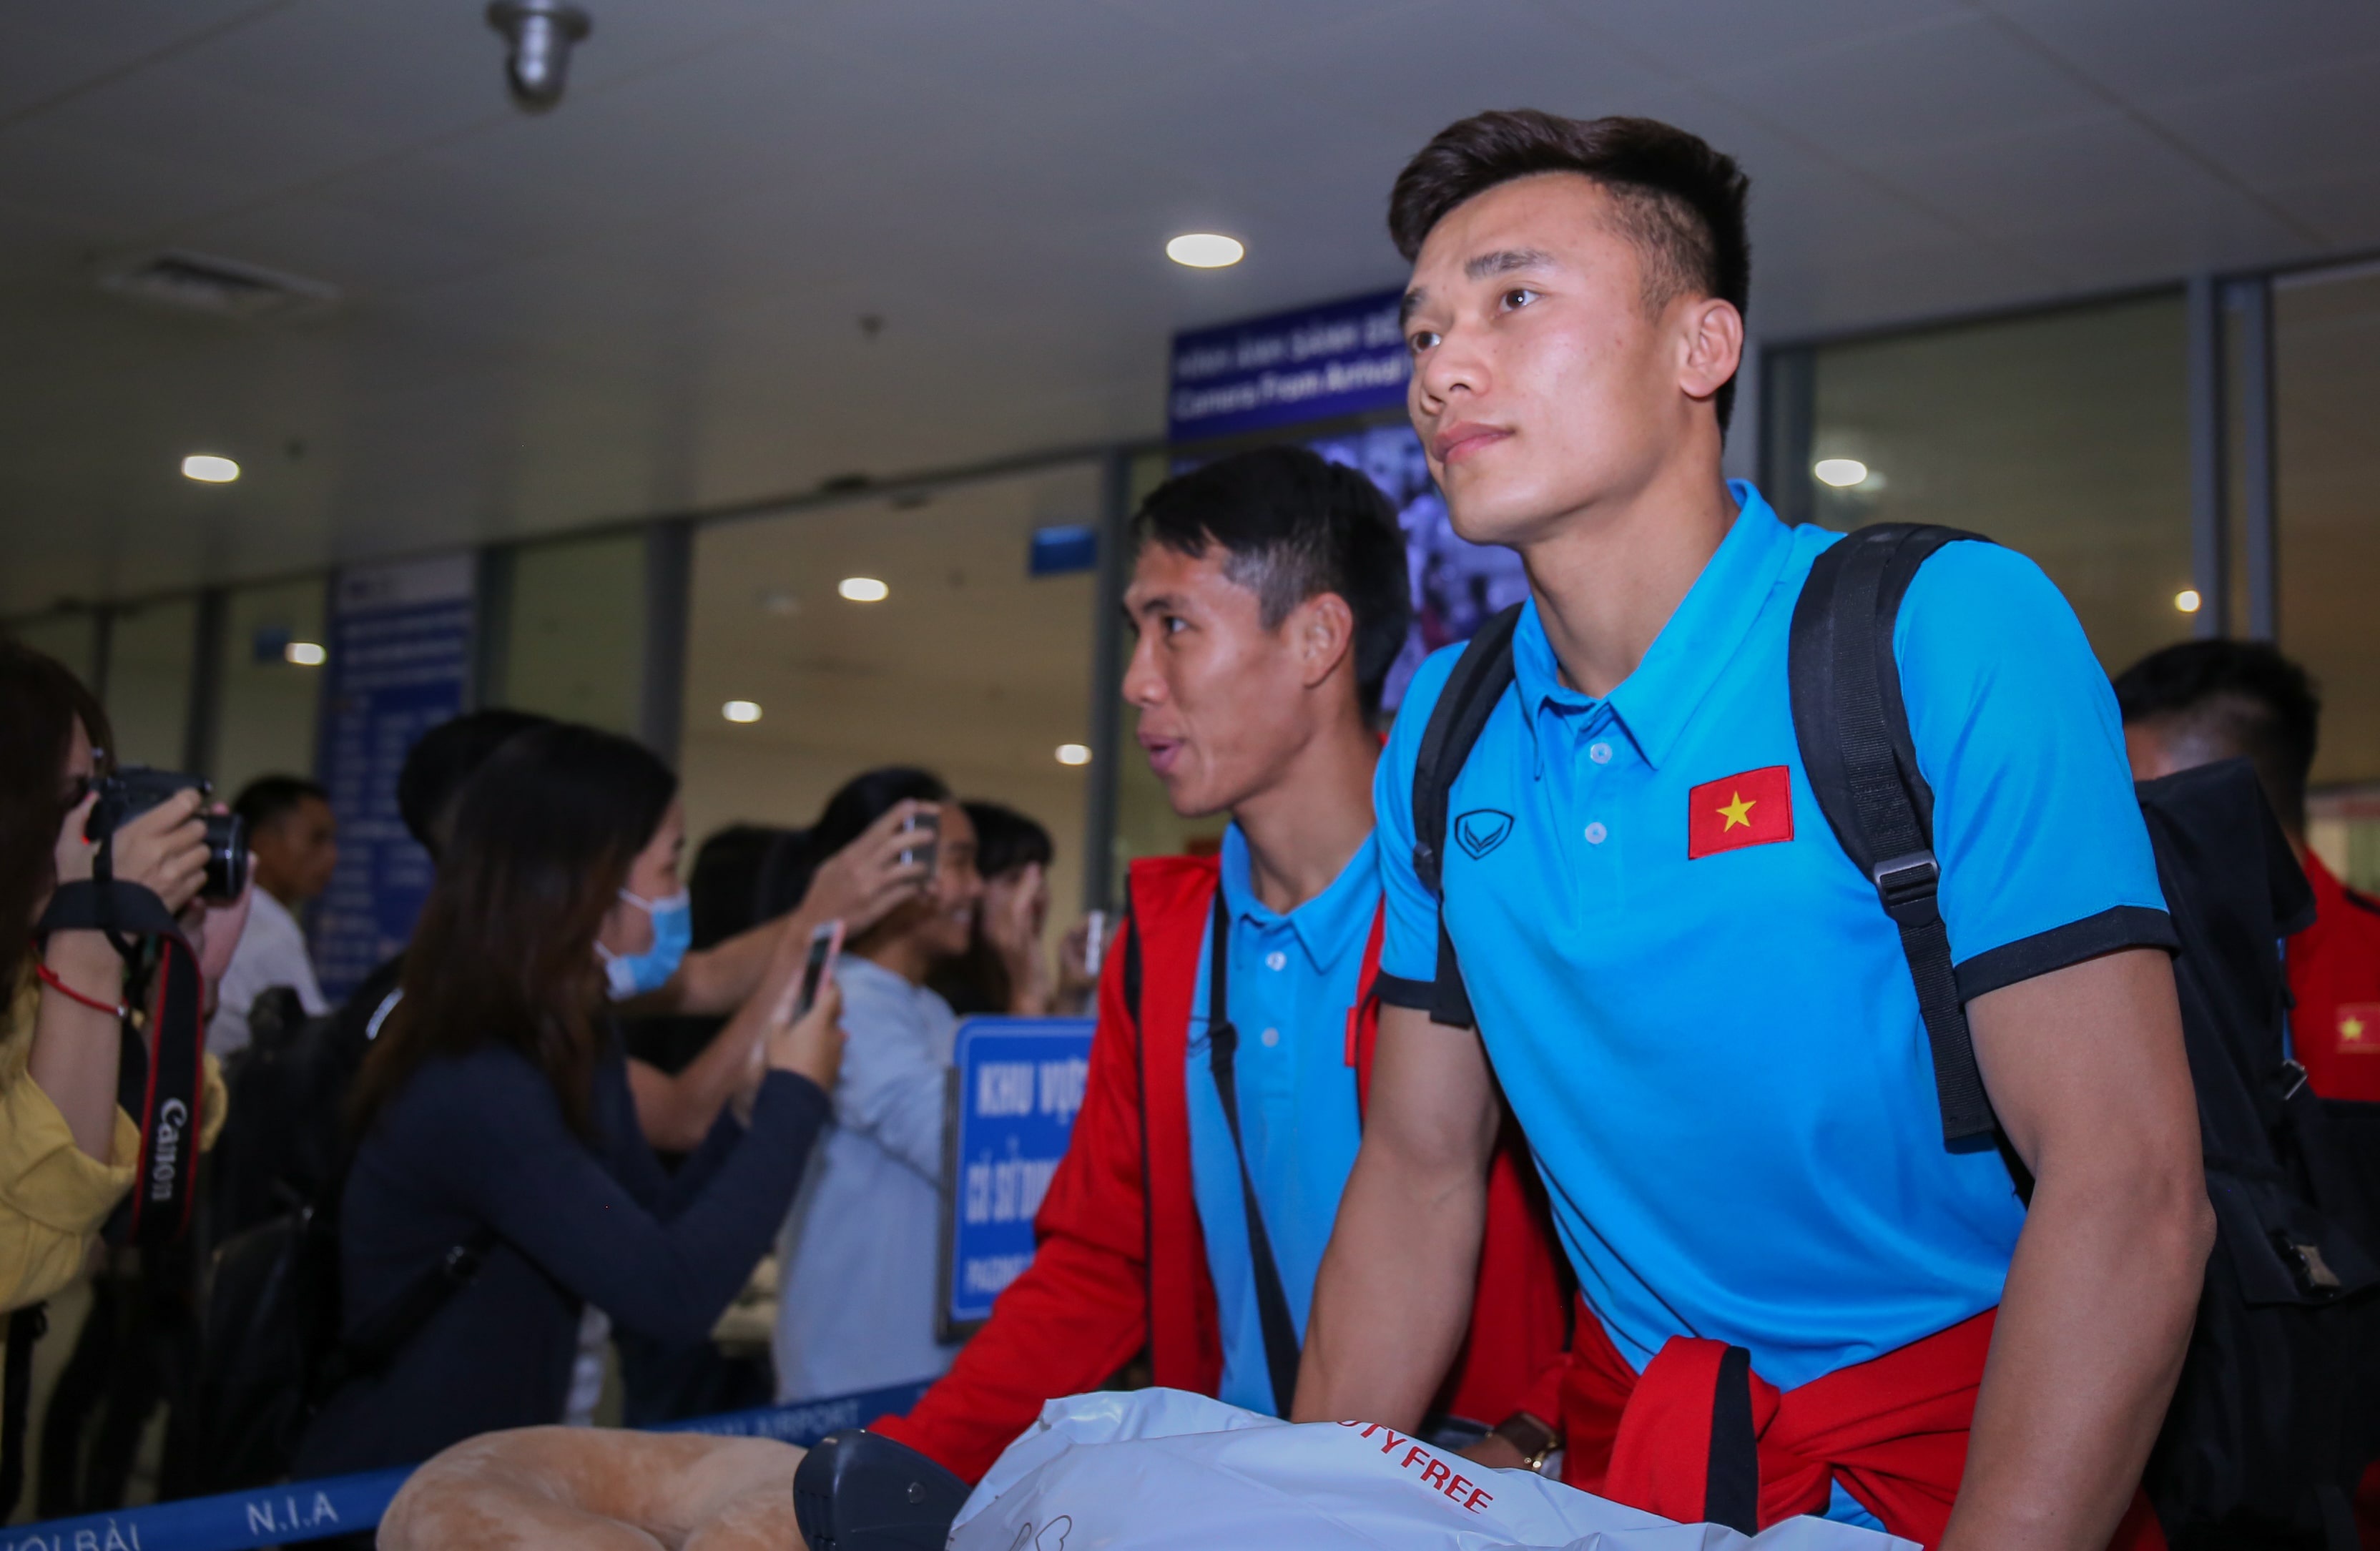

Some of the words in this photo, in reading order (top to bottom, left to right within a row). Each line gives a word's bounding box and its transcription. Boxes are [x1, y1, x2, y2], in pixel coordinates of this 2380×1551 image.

[1257, 371, 1319, 402] From
[1325, 358, 1402, 391] Arrival
[978, 1061, 1035, 1117] KHU
[152, 1098, 188, 1201] Canon
[1337, 1420, 1408, 1454] TY
[1401, 1446, 1494, 1515] FREE
[246, 1491, 339, 1536] N.I.A
